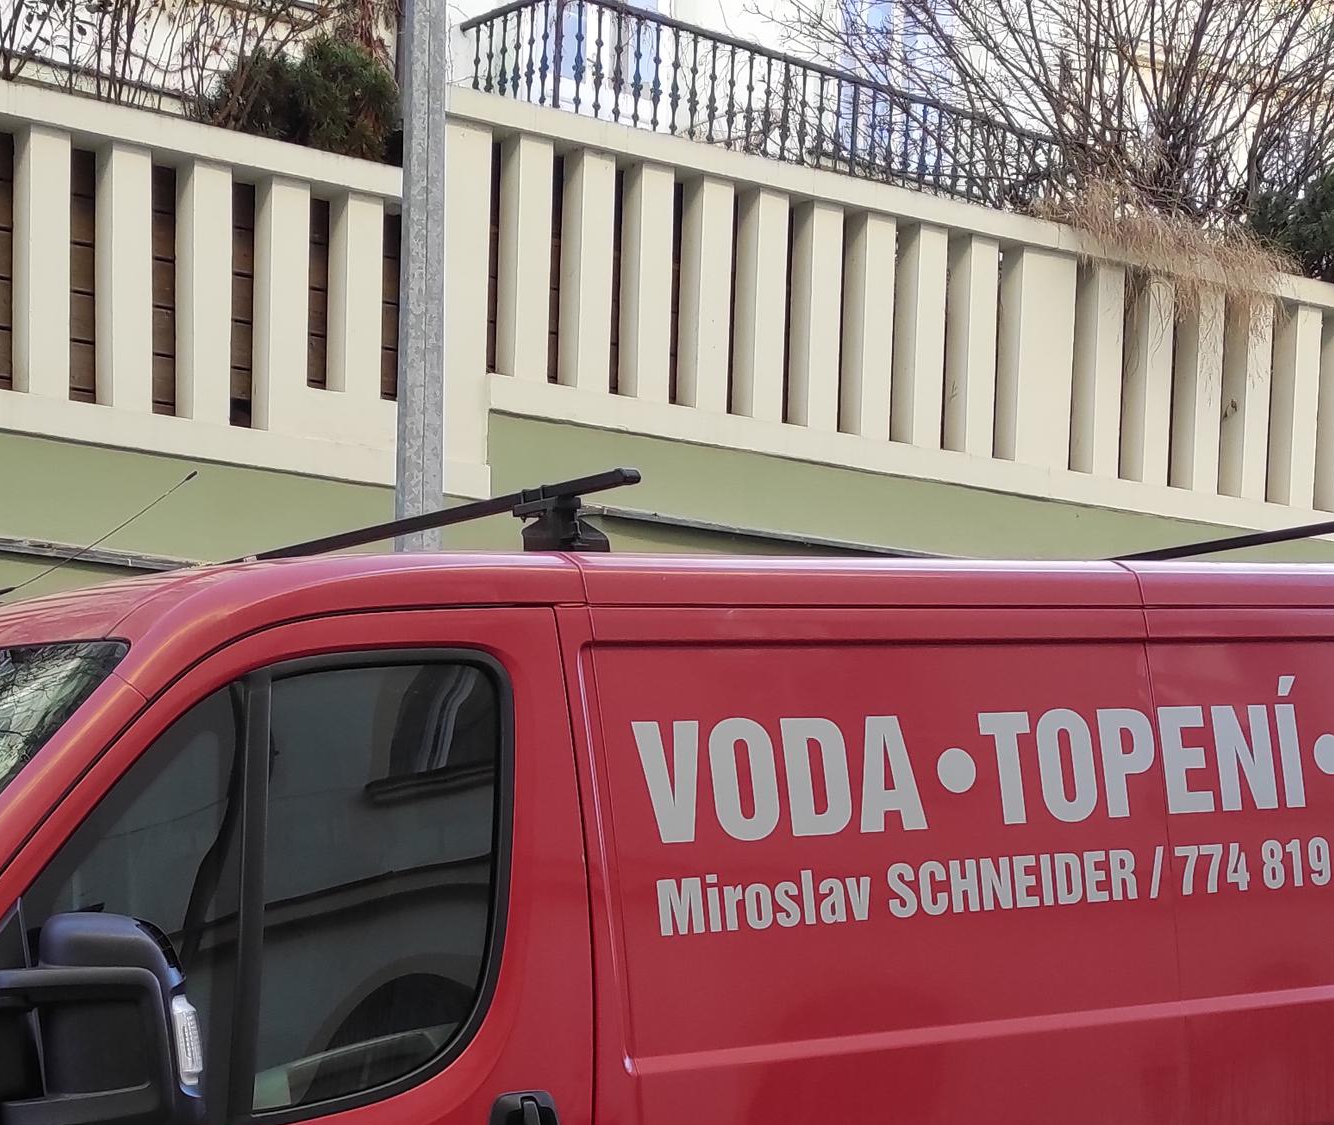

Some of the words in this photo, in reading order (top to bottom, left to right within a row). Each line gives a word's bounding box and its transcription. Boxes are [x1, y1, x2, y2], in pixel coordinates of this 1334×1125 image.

[631, 715, 928, 844] VODA
[977, 675, 1306, 825] TOPENÍ
[656, 863, 871, 936] Miroslav
[888, 849, 1138, 918] SCHNEIDER
[1175, 842, 1250, 896] 774
[1262, 836, 1331, 890] 819
